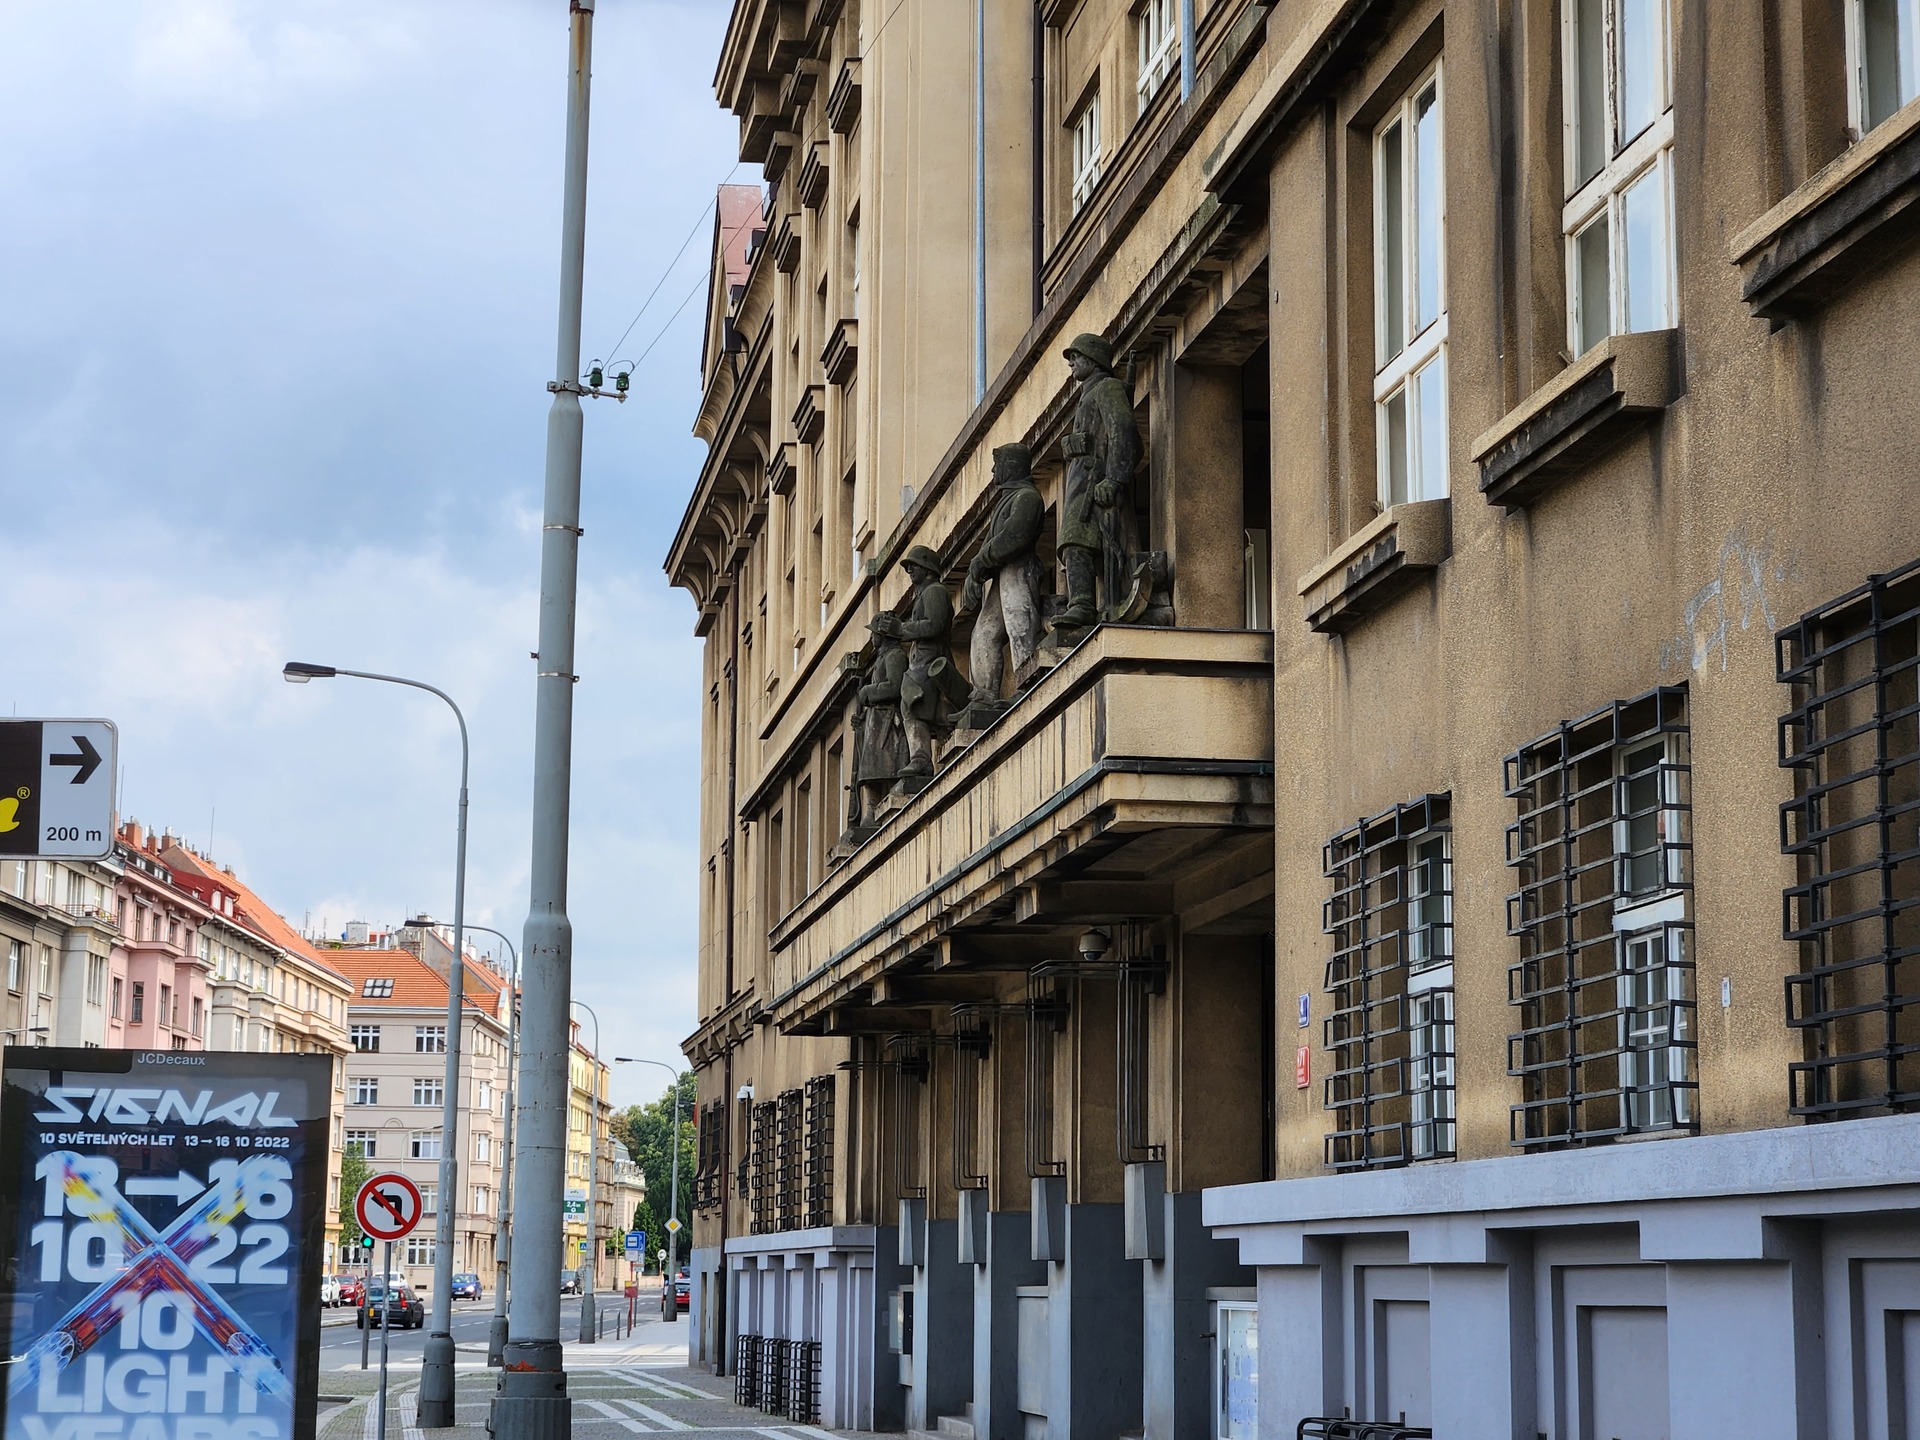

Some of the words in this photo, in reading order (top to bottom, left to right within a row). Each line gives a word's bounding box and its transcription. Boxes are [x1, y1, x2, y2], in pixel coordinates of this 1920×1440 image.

[46, 826, 79, 842] 200
[85, 829, 102, 842] m
[137, 1053, 206, 1066] JCDecaux
[32, 1087, 300, 1128] SIGNAL
[39, 1132, 55, 1144] 10
[57, 1131, 148, 1146] SVĚTELNÝCH
[150, 1134, 176, 1147] LET
[184, 1135, 199, 1147] 13
[215, 1135, 230, 1148] 16
[235, 1136, 250, 1148] 10
[254, 1136, 290, 1148] 2022
[208, 1154, 293, 1220] 16
[31, 1220, 122, 1283] 10
[186, 1223, 290, 1285] 22
[111, 1291, 196, 1351] 10
[36, 1354, 266, 1414] LIGHT
